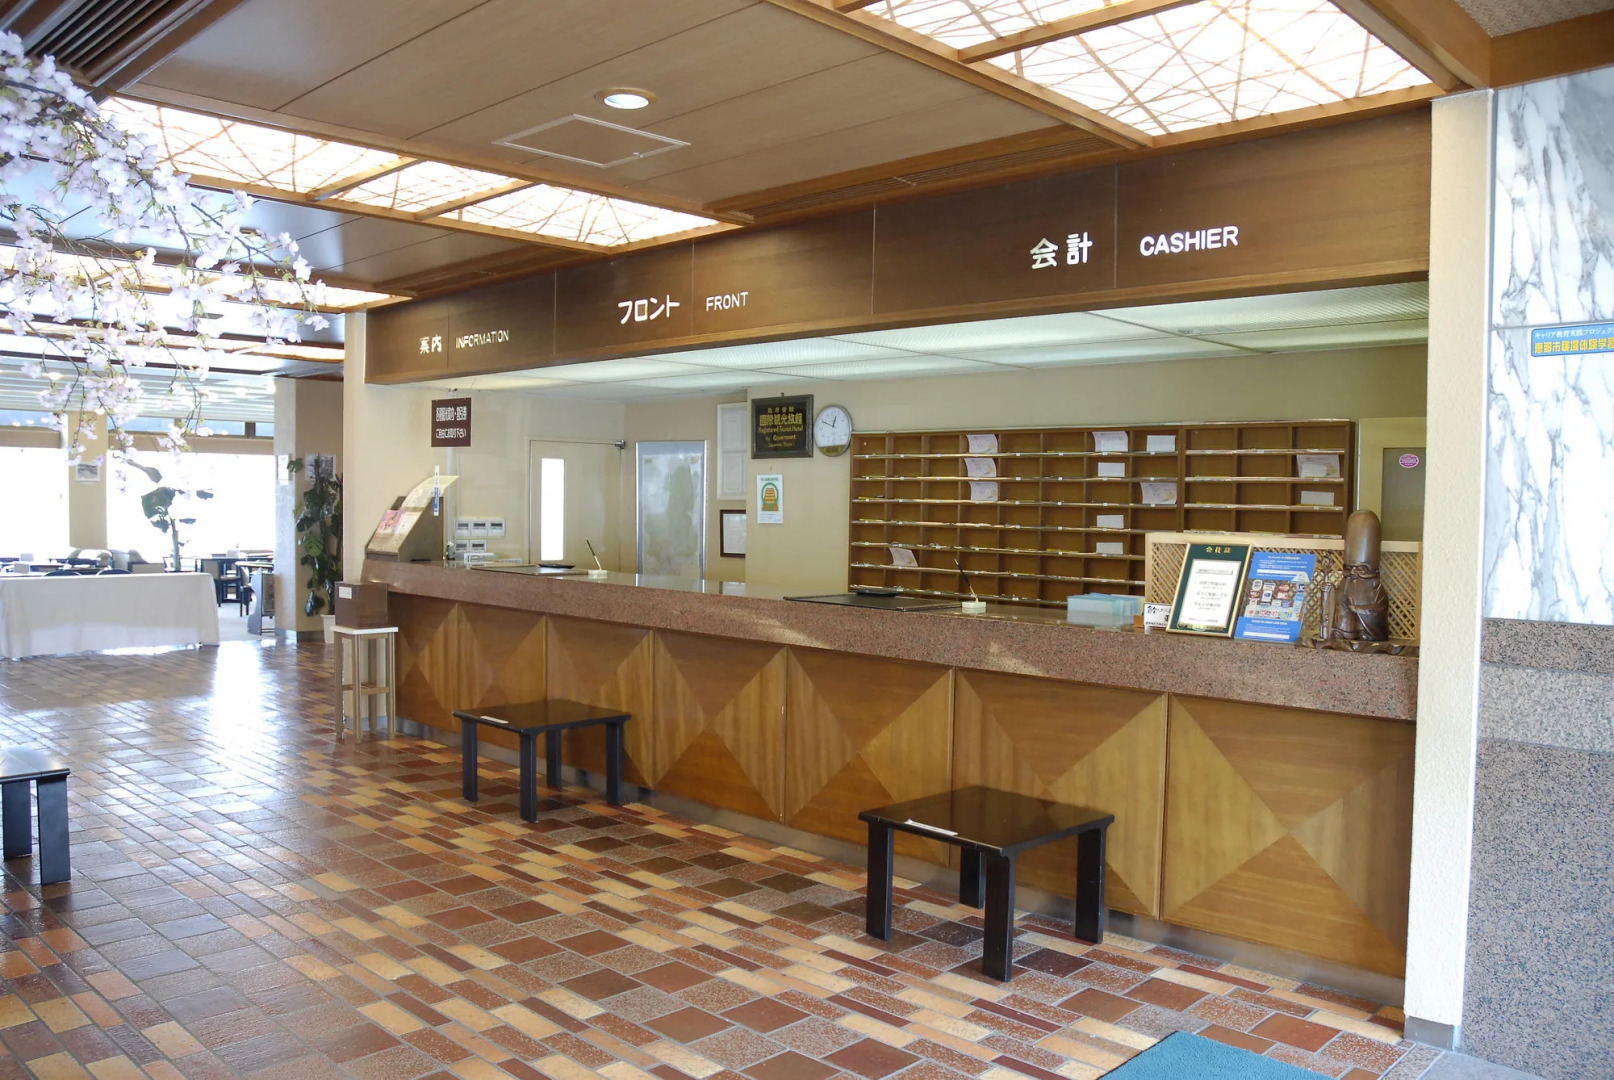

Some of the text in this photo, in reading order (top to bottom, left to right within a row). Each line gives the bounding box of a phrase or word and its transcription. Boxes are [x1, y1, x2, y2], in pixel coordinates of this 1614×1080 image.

[1029, 231, 1093, 270] 会計
[1139, 225, 1239, 257] CASHIER
[617, 294, 680, 325] フロント
[705, 291, 749, 312] FRONT
[419, 334, 442, 354] 案内
[456, 329, 509, 349] INFORMATION
